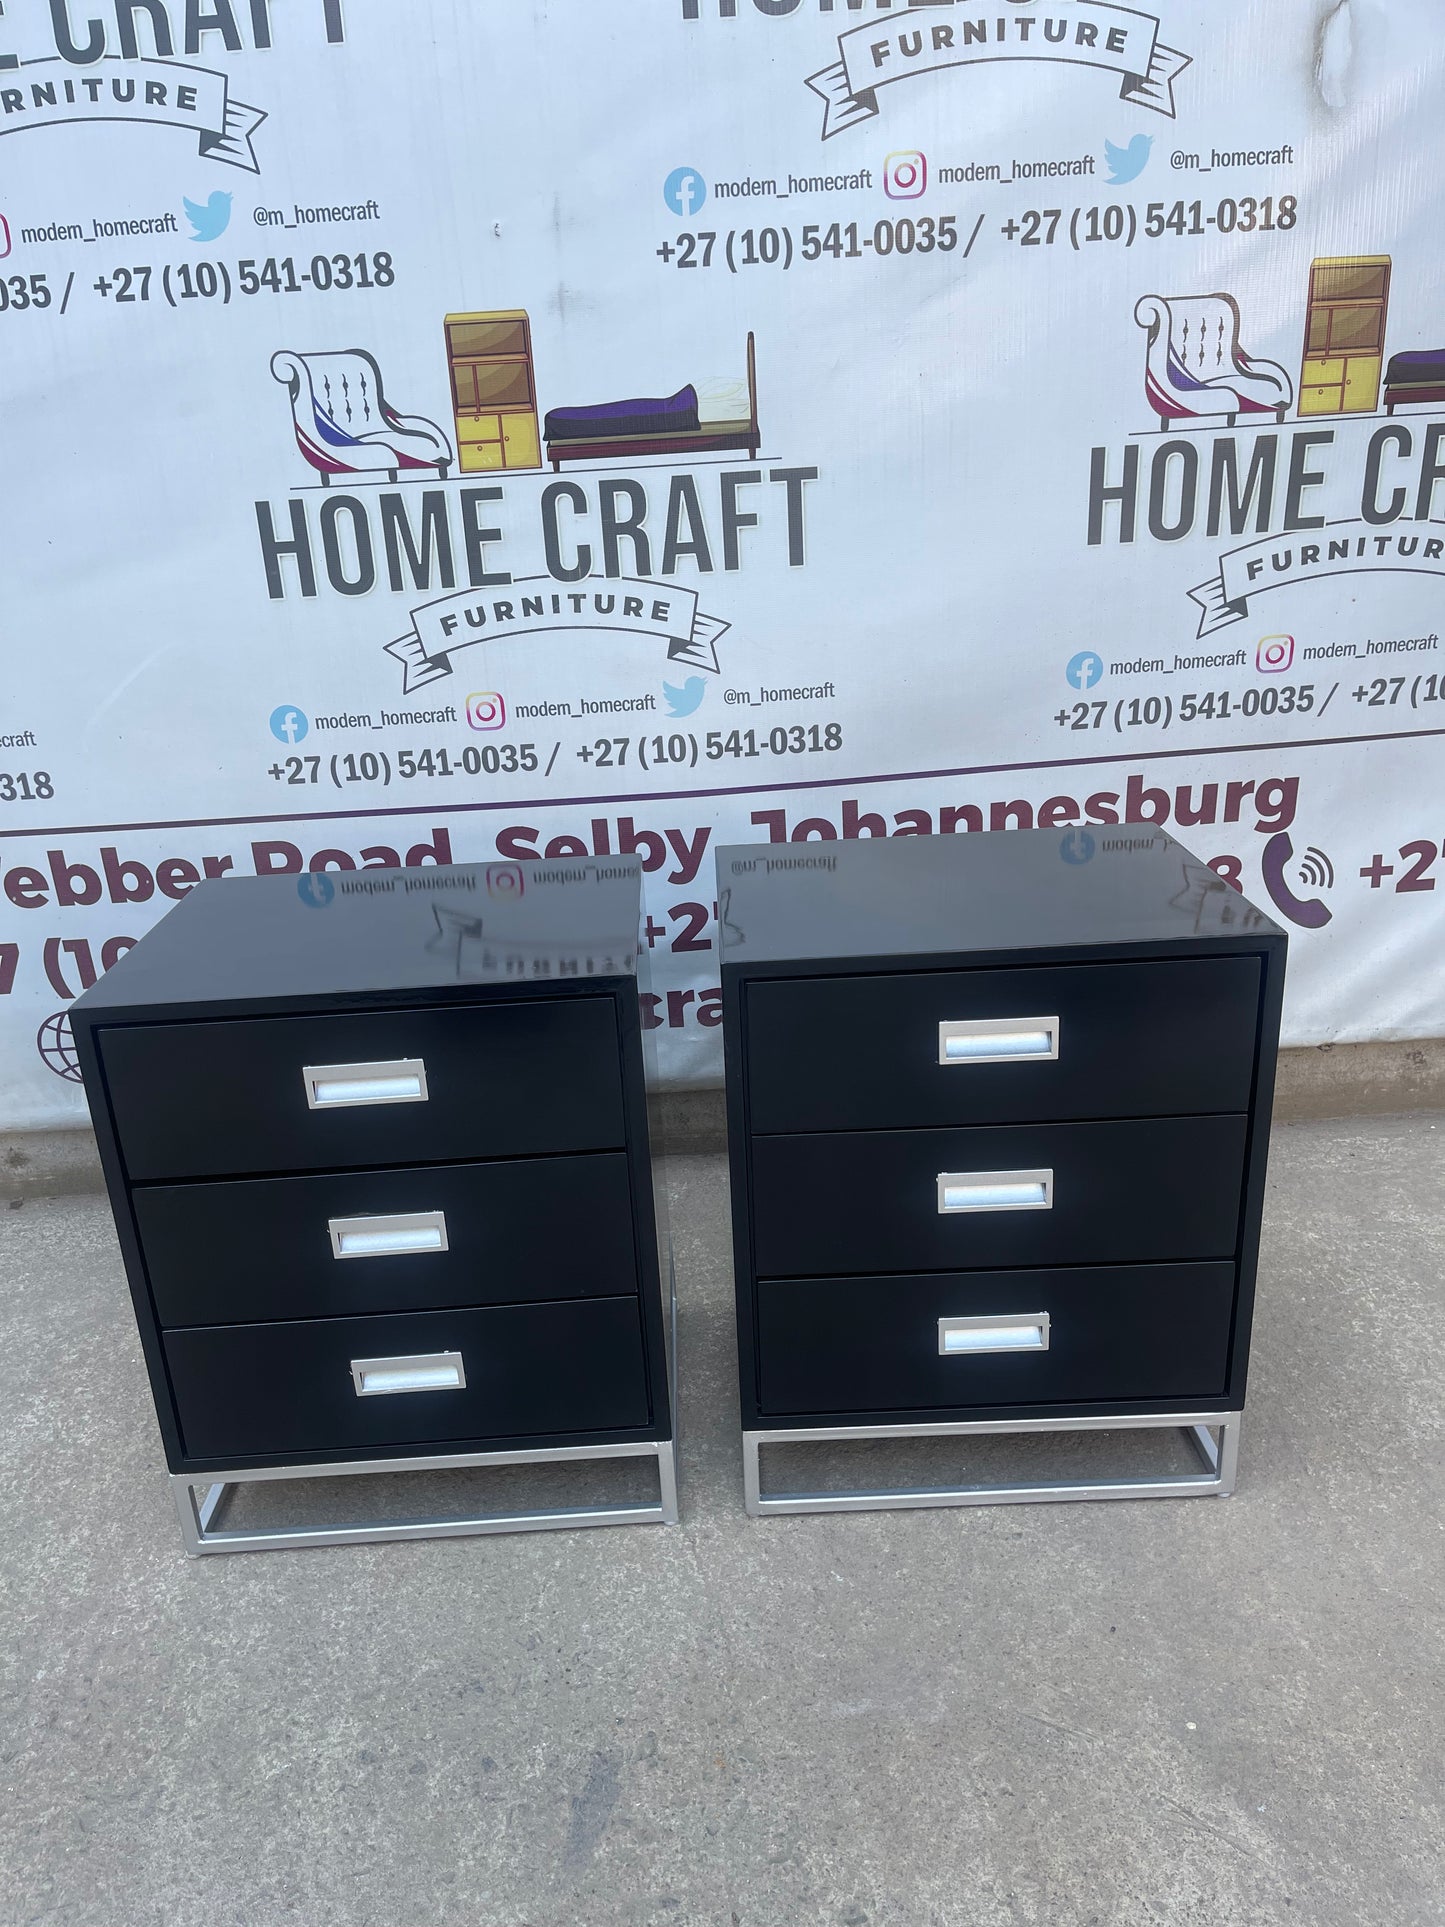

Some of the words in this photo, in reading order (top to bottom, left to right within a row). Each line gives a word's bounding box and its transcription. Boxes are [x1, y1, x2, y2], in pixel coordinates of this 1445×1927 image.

[870, 18, 1128, 68] FURNITURE
[714, 169, 873, 199] modern_homecraft
[938, 155, 1096, 184] modern_homecraft
[1170, 145, 1294, 172] @m_homecraft
[21, 213, 178, 244] modern_homecraft
[253, 200, 380, 229] @m_homecraft
[656, 232, 716, 269] +27
[725, 227, 794, 274] (10)
[801, 216, 958, 260] 541-0035
[1001, 209, 1062, 246] +27
[1069, 205, 1137, 250] (10)
[1145, 195, 1298, 238] 541-0318
[93, 266, 153, 303] +27
[162, 262, 232, 307] (10)
[238, 251, 395, 294] 541-0318
[1087, 430, 1335, 546] HOME
[254, 486, 512, 599] HOME
[540, 466, 819, 583] CRAFT
[439, 593, 671, 637] FURNITURE
[1109, 649, 1247, 676] modern_homecraft
[1303, 634, 1439, 661] modern_homecraft
[314, 705, 457, 732] modern_homecraft
[514, 694, 657, 720] modern_homecraft
[723, 682, 835, 706] @m_homecraft
[1053, 701, 1108, 731] +27
[1113, 696, 1173, 733] (10)
[1179, 684, 1315, 722] 541-0035
[1352, 676, 1405, 707] +27
[267, 755, 321, 786] +27
[329, 752, 392, 788] (10)
[398, 742, 538, 779] 541-0035
[576, 738, 629, 768] +27
[638, 733, 698, 770] (10)
[705, 722, 843, 761] 541-0318
[0, 771, 54, 802] 318
